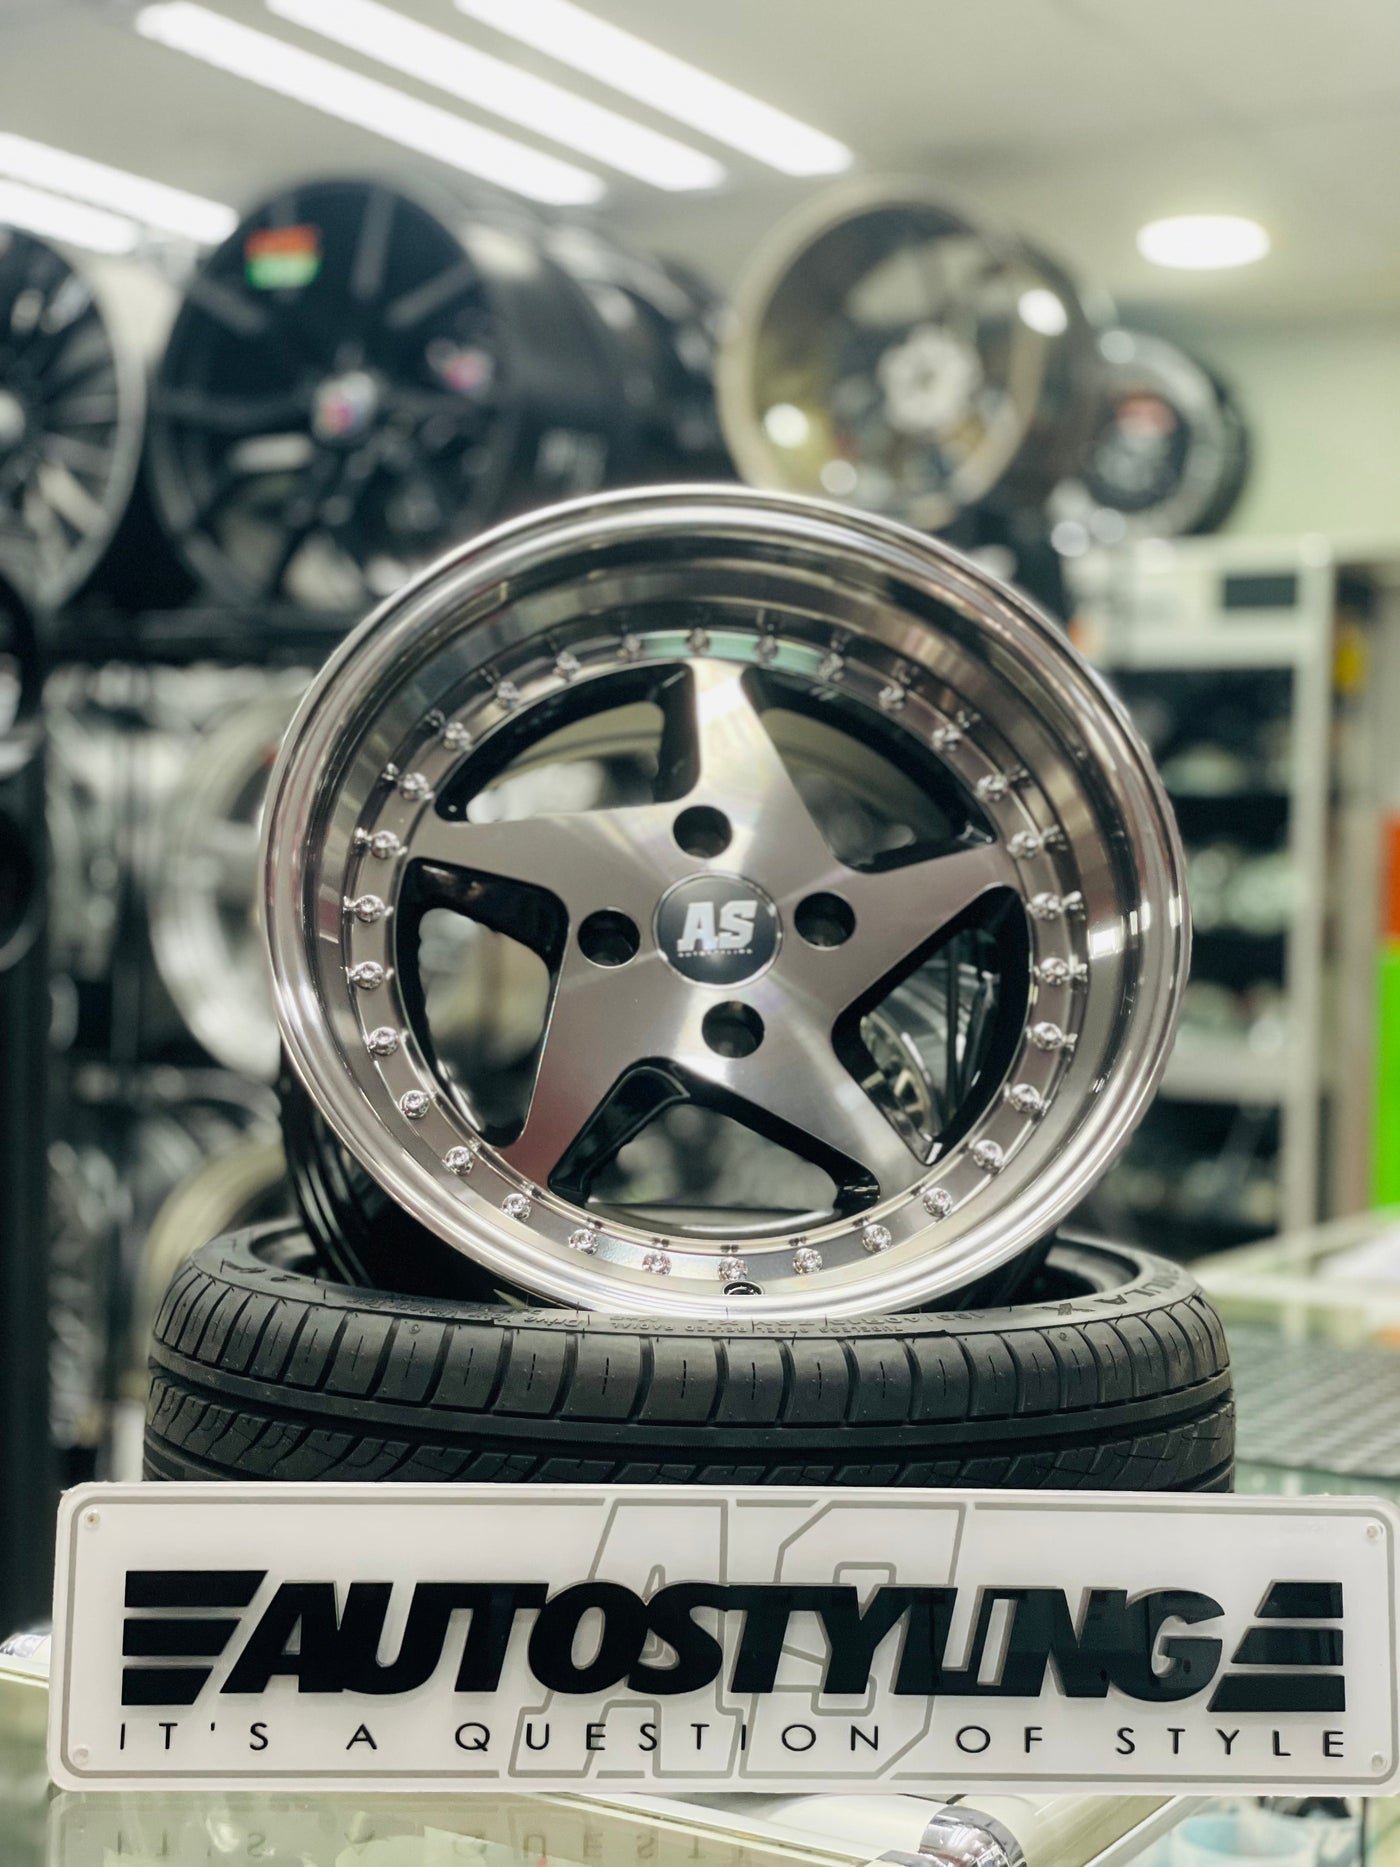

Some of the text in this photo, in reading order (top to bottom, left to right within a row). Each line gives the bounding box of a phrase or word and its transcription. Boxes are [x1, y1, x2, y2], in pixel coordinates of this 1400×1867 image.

[677, 900, 758, 952] AS
[219, 1580, 1225, 1703] AUTOSTYLING
[120, 1721, 1344, 1758] IT'S A QUESTION OF STYLE
